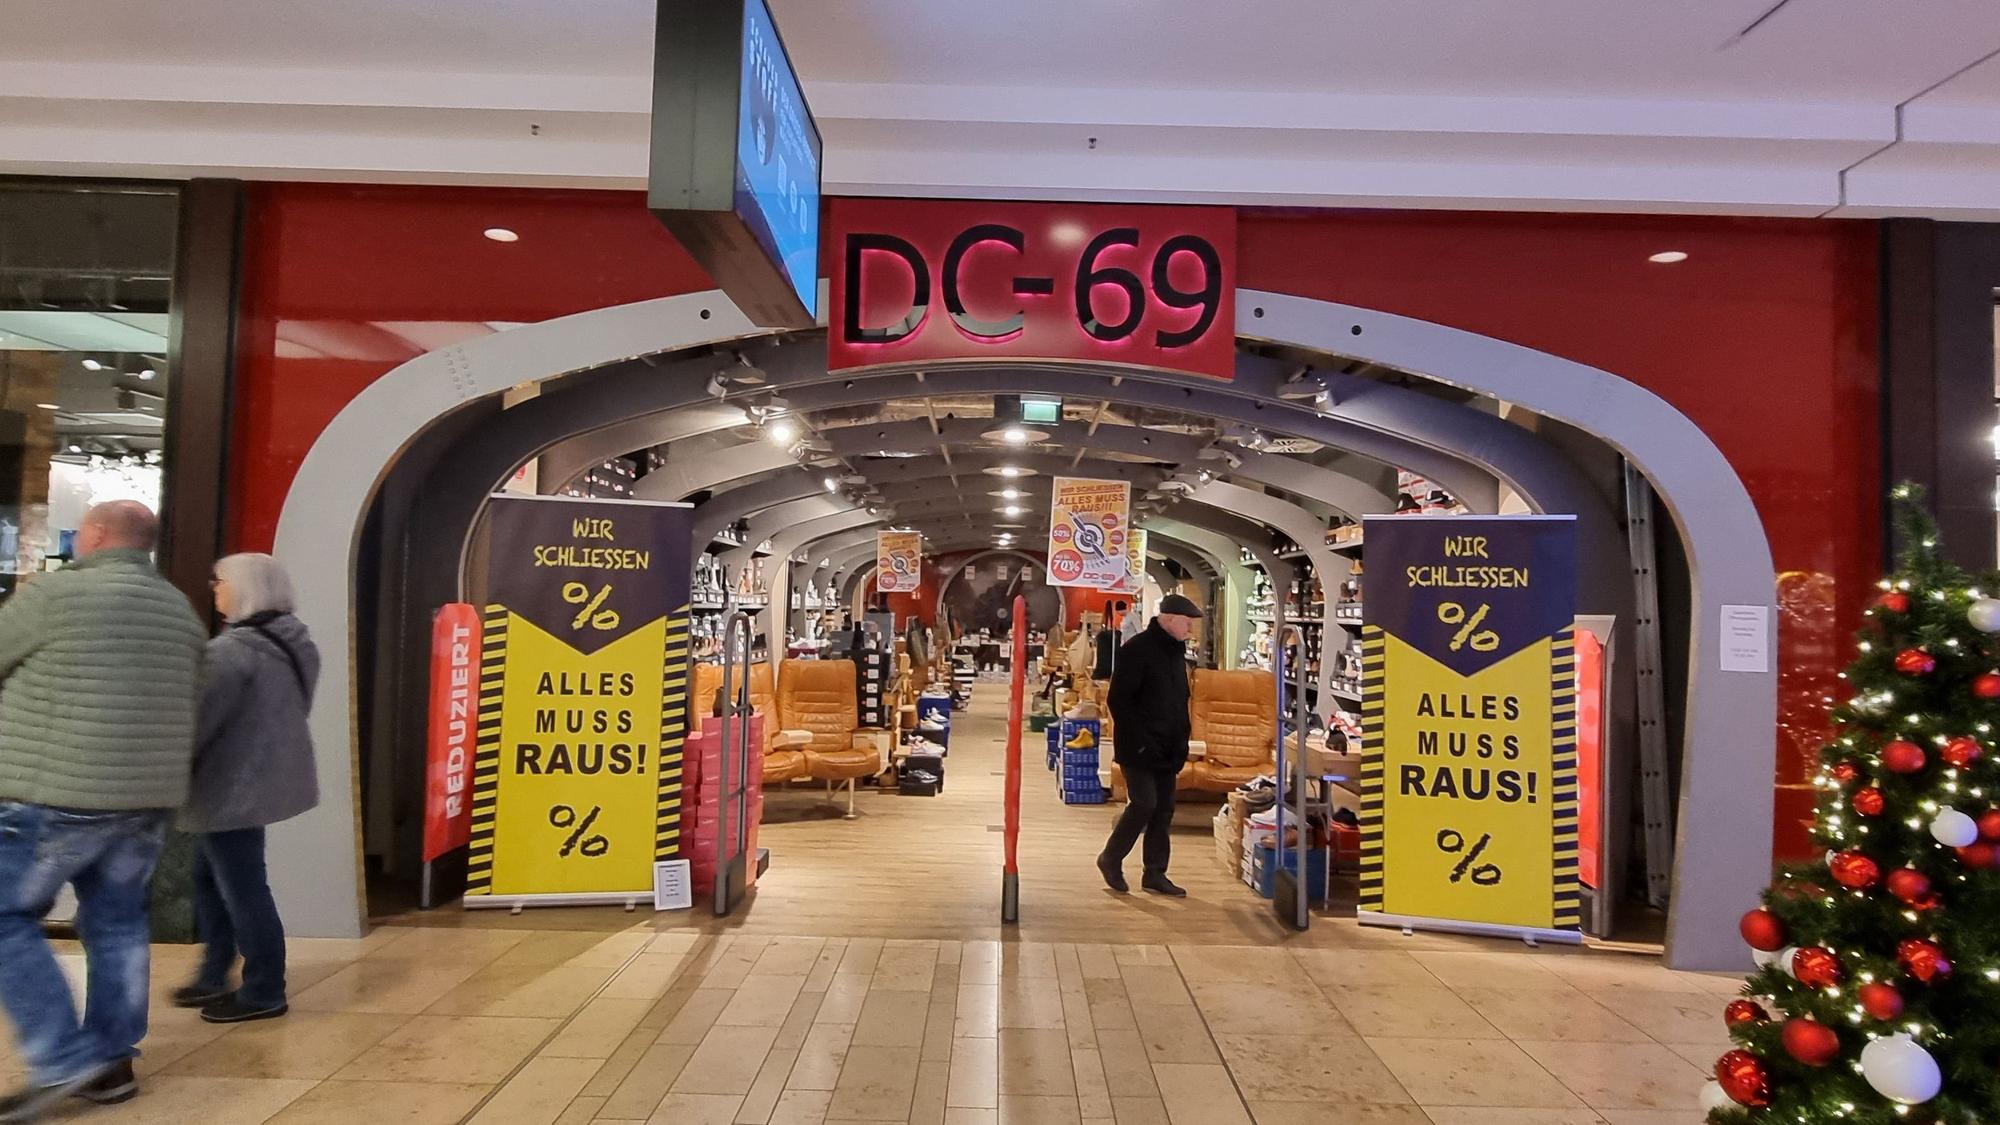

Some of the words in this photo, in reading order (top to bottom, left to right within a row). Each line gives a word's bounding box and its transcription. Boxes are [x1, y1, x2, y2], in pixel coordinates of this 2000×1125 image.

[844, 223, 1222, 348] DC-69
[1057, 496, 1092, 505] ALLES
[1095, 493, 1126, 503] MUSS
[572, 518, 614, 541] WIR
[534, 546, 649, 571] SCHLIESSEN
[1445, 536, 1489, 559] WIR
[1407, 566, 1529, 589] SCHLIESSEN
[563, 582, 619, 630] %
[1437, 602, 1500, 652] %
[537, 671, 633, 696] ALLES
[446, 622, 471, 819] REDUZIERT
[1417, 693, 1521, 720] ALLES
[536, 709, 632, 734] MUSS
[515, 743, 647, 776] RAUS!
[1418, 731, 1520, 760] MUSS
[1400, 765, 1537, 804] RAUS!
[549, 805, 609, 857] %
[1437, 829, 1501, 885] %
